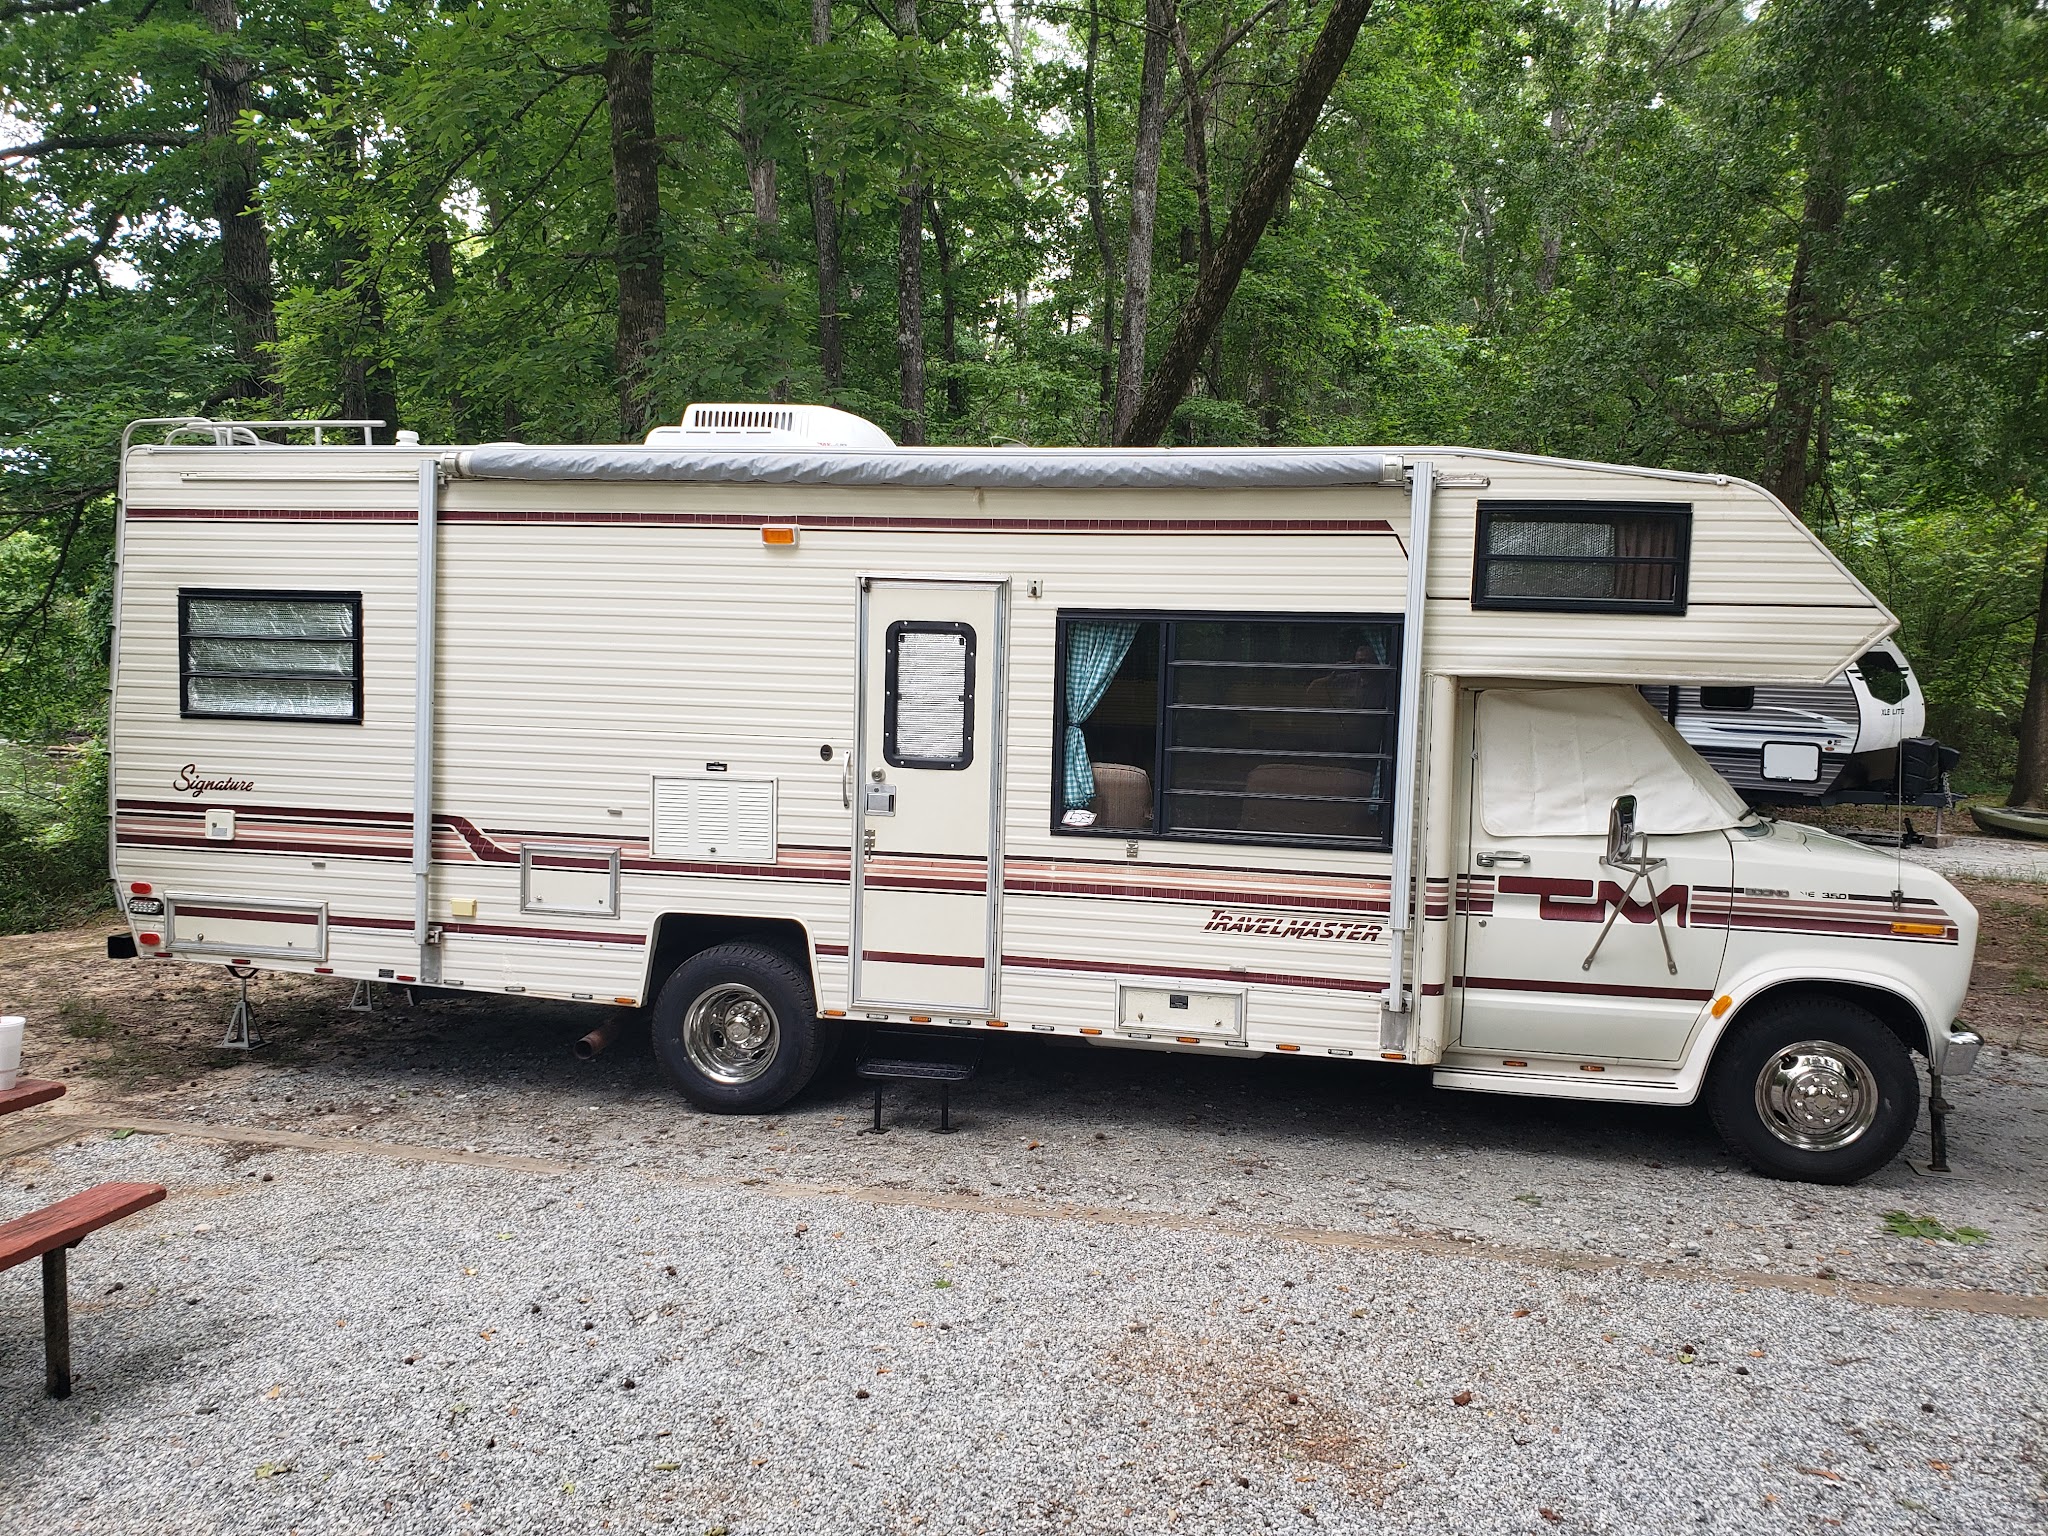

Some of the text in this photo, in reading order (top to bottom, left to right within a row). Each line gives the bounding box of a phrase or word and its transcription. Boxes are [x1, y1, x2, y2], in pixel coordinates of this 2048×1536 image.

[173, 763, 254, 797] Signature
[1822, 892, 1847, 900] 350
[1204, 909, 1383, 942] TRAVELMASTER
